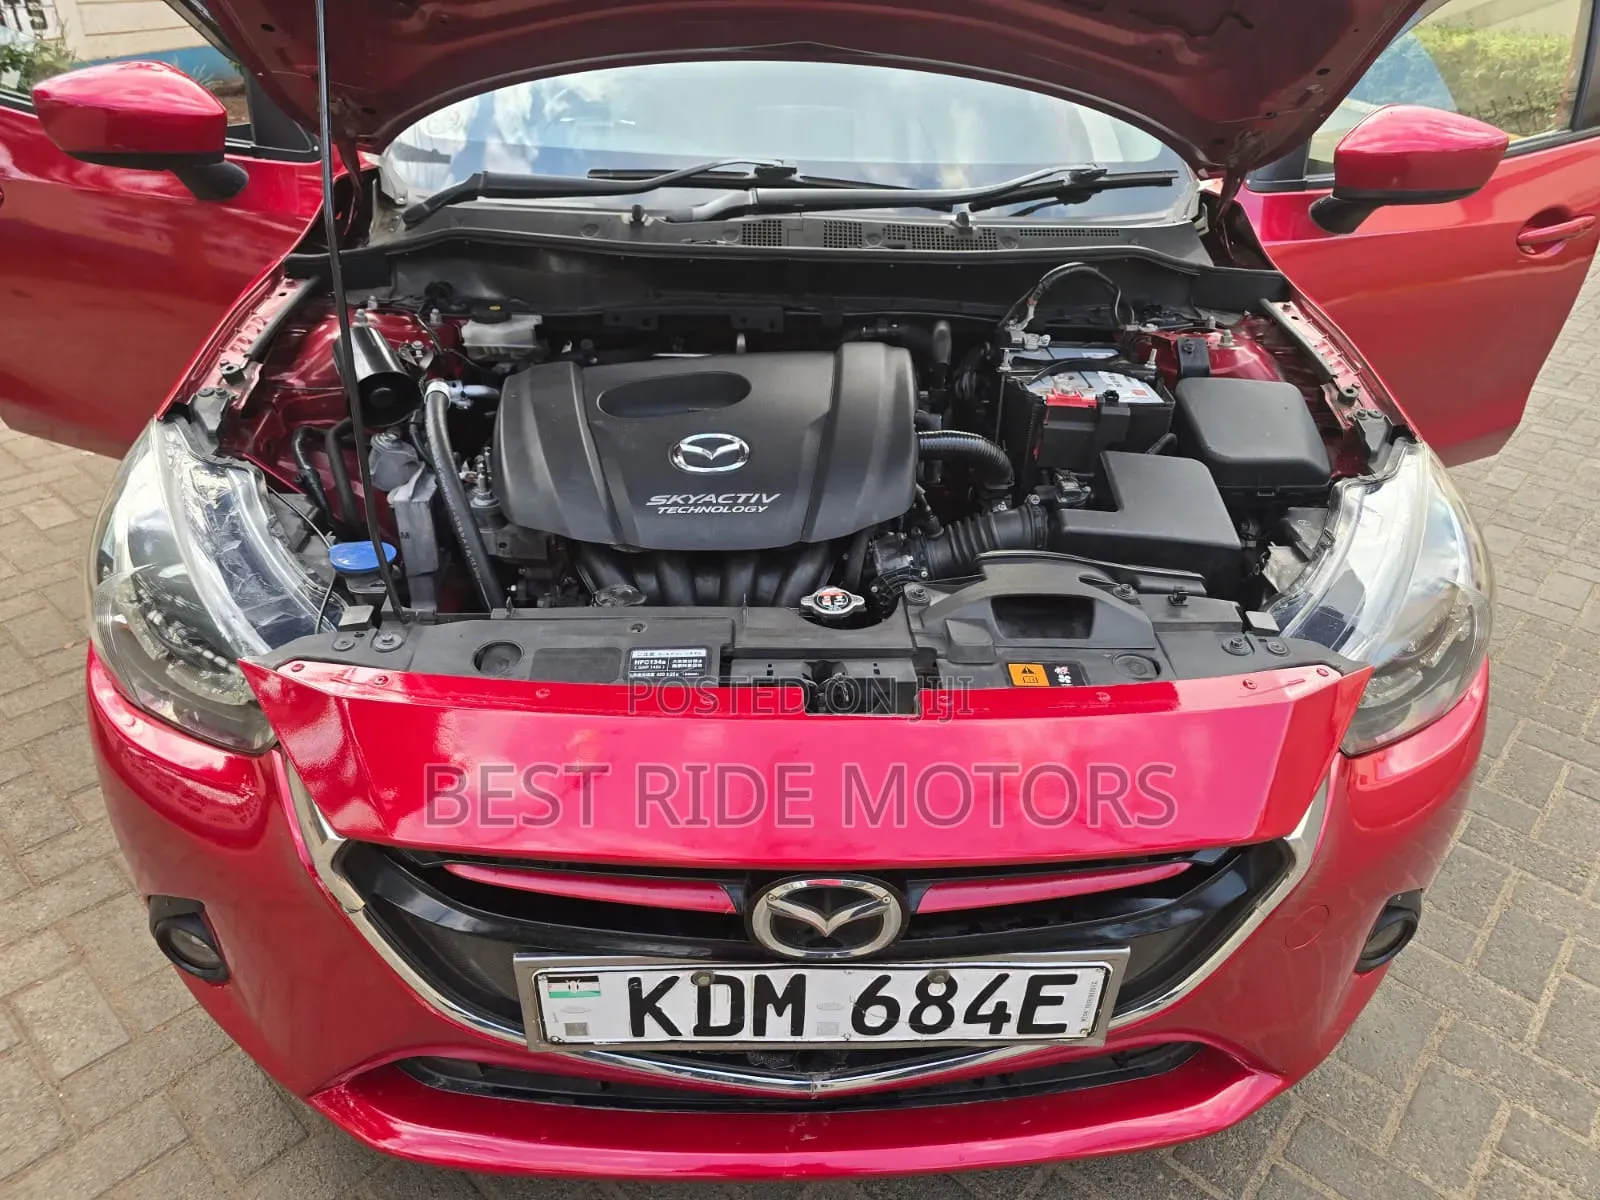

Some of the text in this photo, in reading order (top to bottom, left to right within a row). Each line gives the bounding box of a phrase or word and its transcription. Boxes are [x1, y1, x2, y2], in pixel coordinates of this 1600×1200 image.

[645, 493, 782, 506] SKYACTIV
[657, 505, 769, 515] TECHNOLOGY
[627, 973, 807, 1038] KDM
[850, 973, 1079, 1036] 684E
